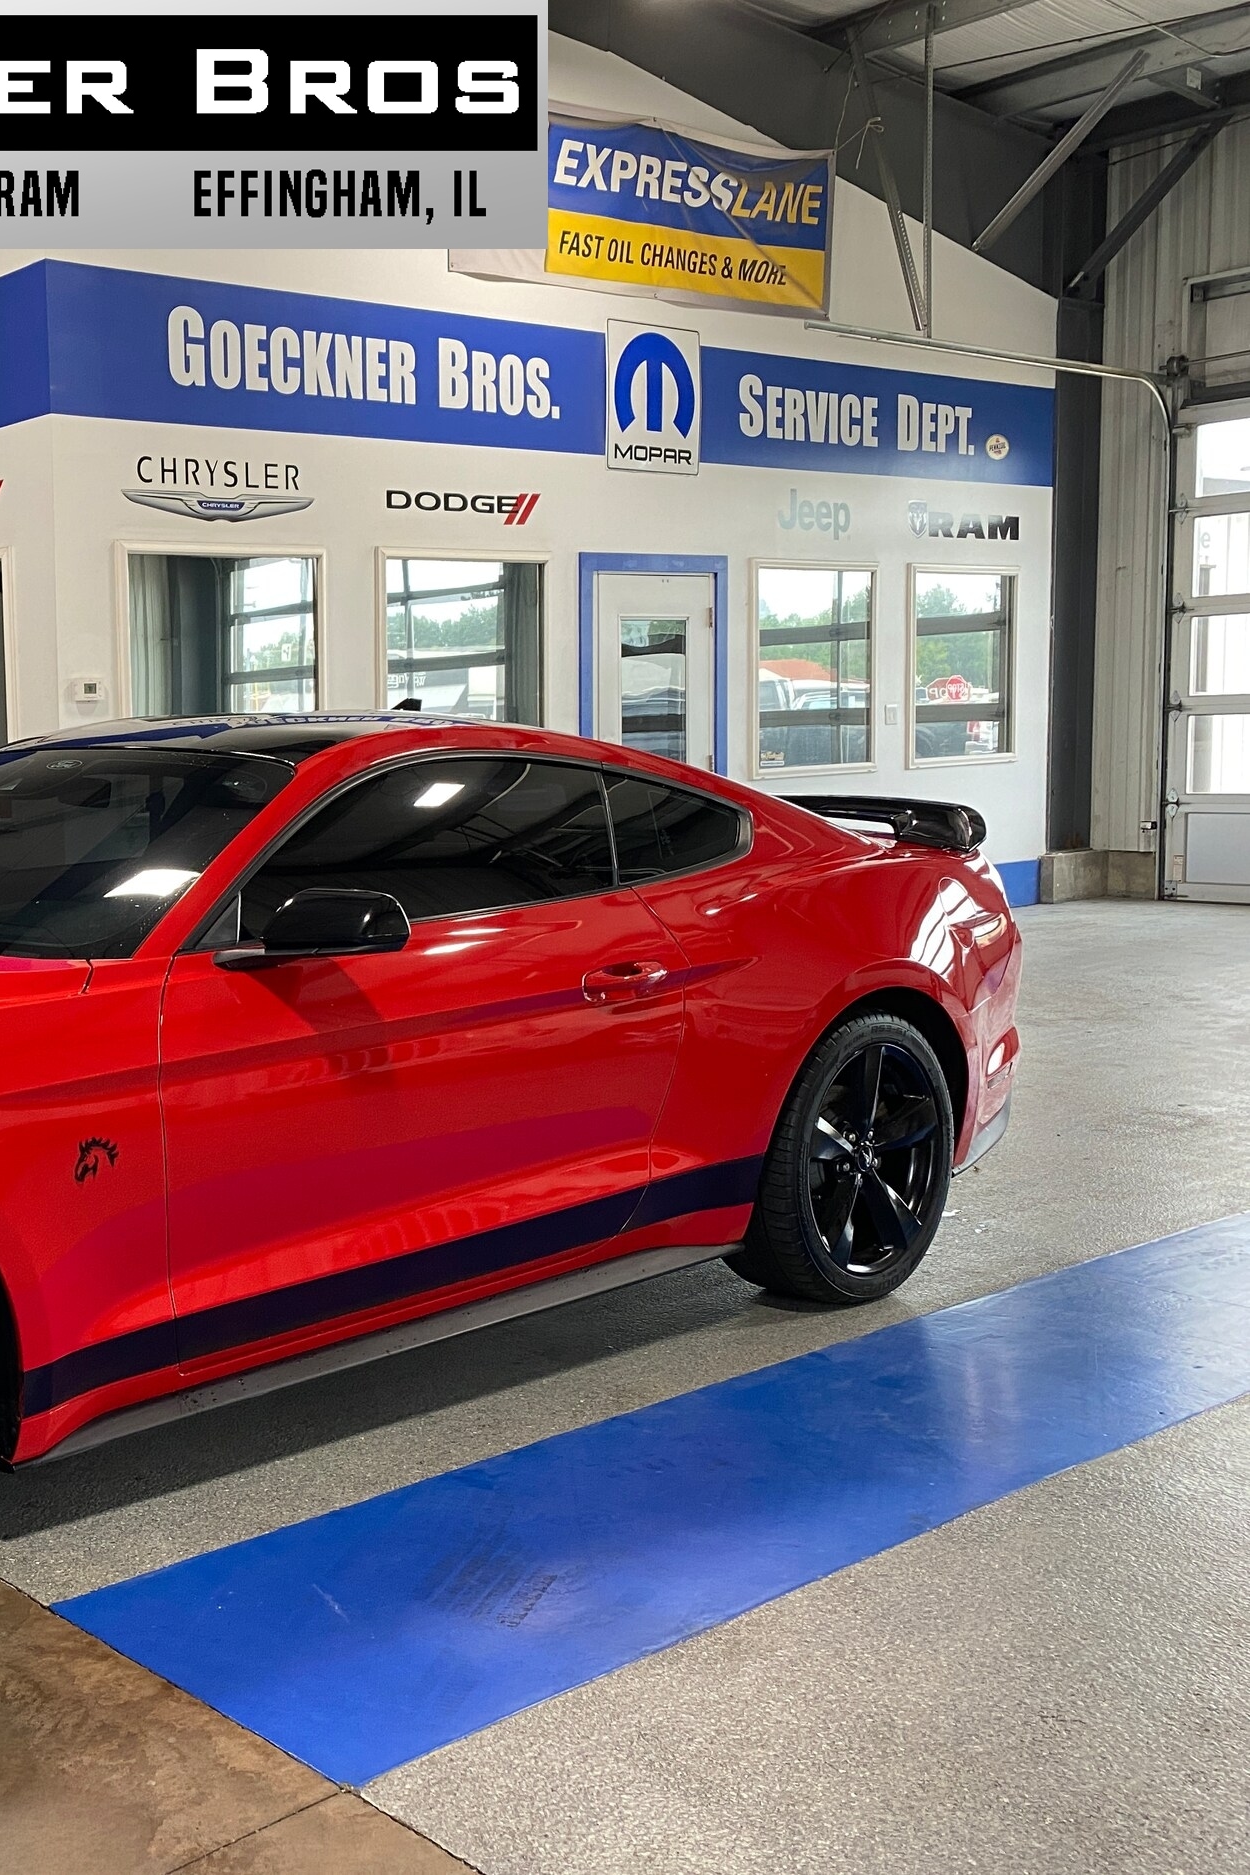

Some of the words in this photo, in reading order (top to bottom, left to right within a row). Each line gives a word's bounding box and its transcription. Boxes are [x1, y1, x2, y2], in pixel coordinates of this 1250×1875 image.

[559, 230, 604, 260] FAST
[607, 238, 634, 264] OIL
[640, 242, 717, 276] CHANGES
[721, 258, 733, 279] &
[738, 259, 787, 286] MORE
[167, 305, 417, 405] GOECKNER
[438, 337, 560, 420] BROS.
[739, 374, 878, 448] SERVICE
[897, 393, 975, 456] DEPT.
[137, 455, 299, 491] CHRYSLER
[614, 443, 692, 466] MOPAR
[386, 490, 520, 517] DODGE
[778, 488, 850, 540] Jeep
[928, 511, 1020, 541] RAM
